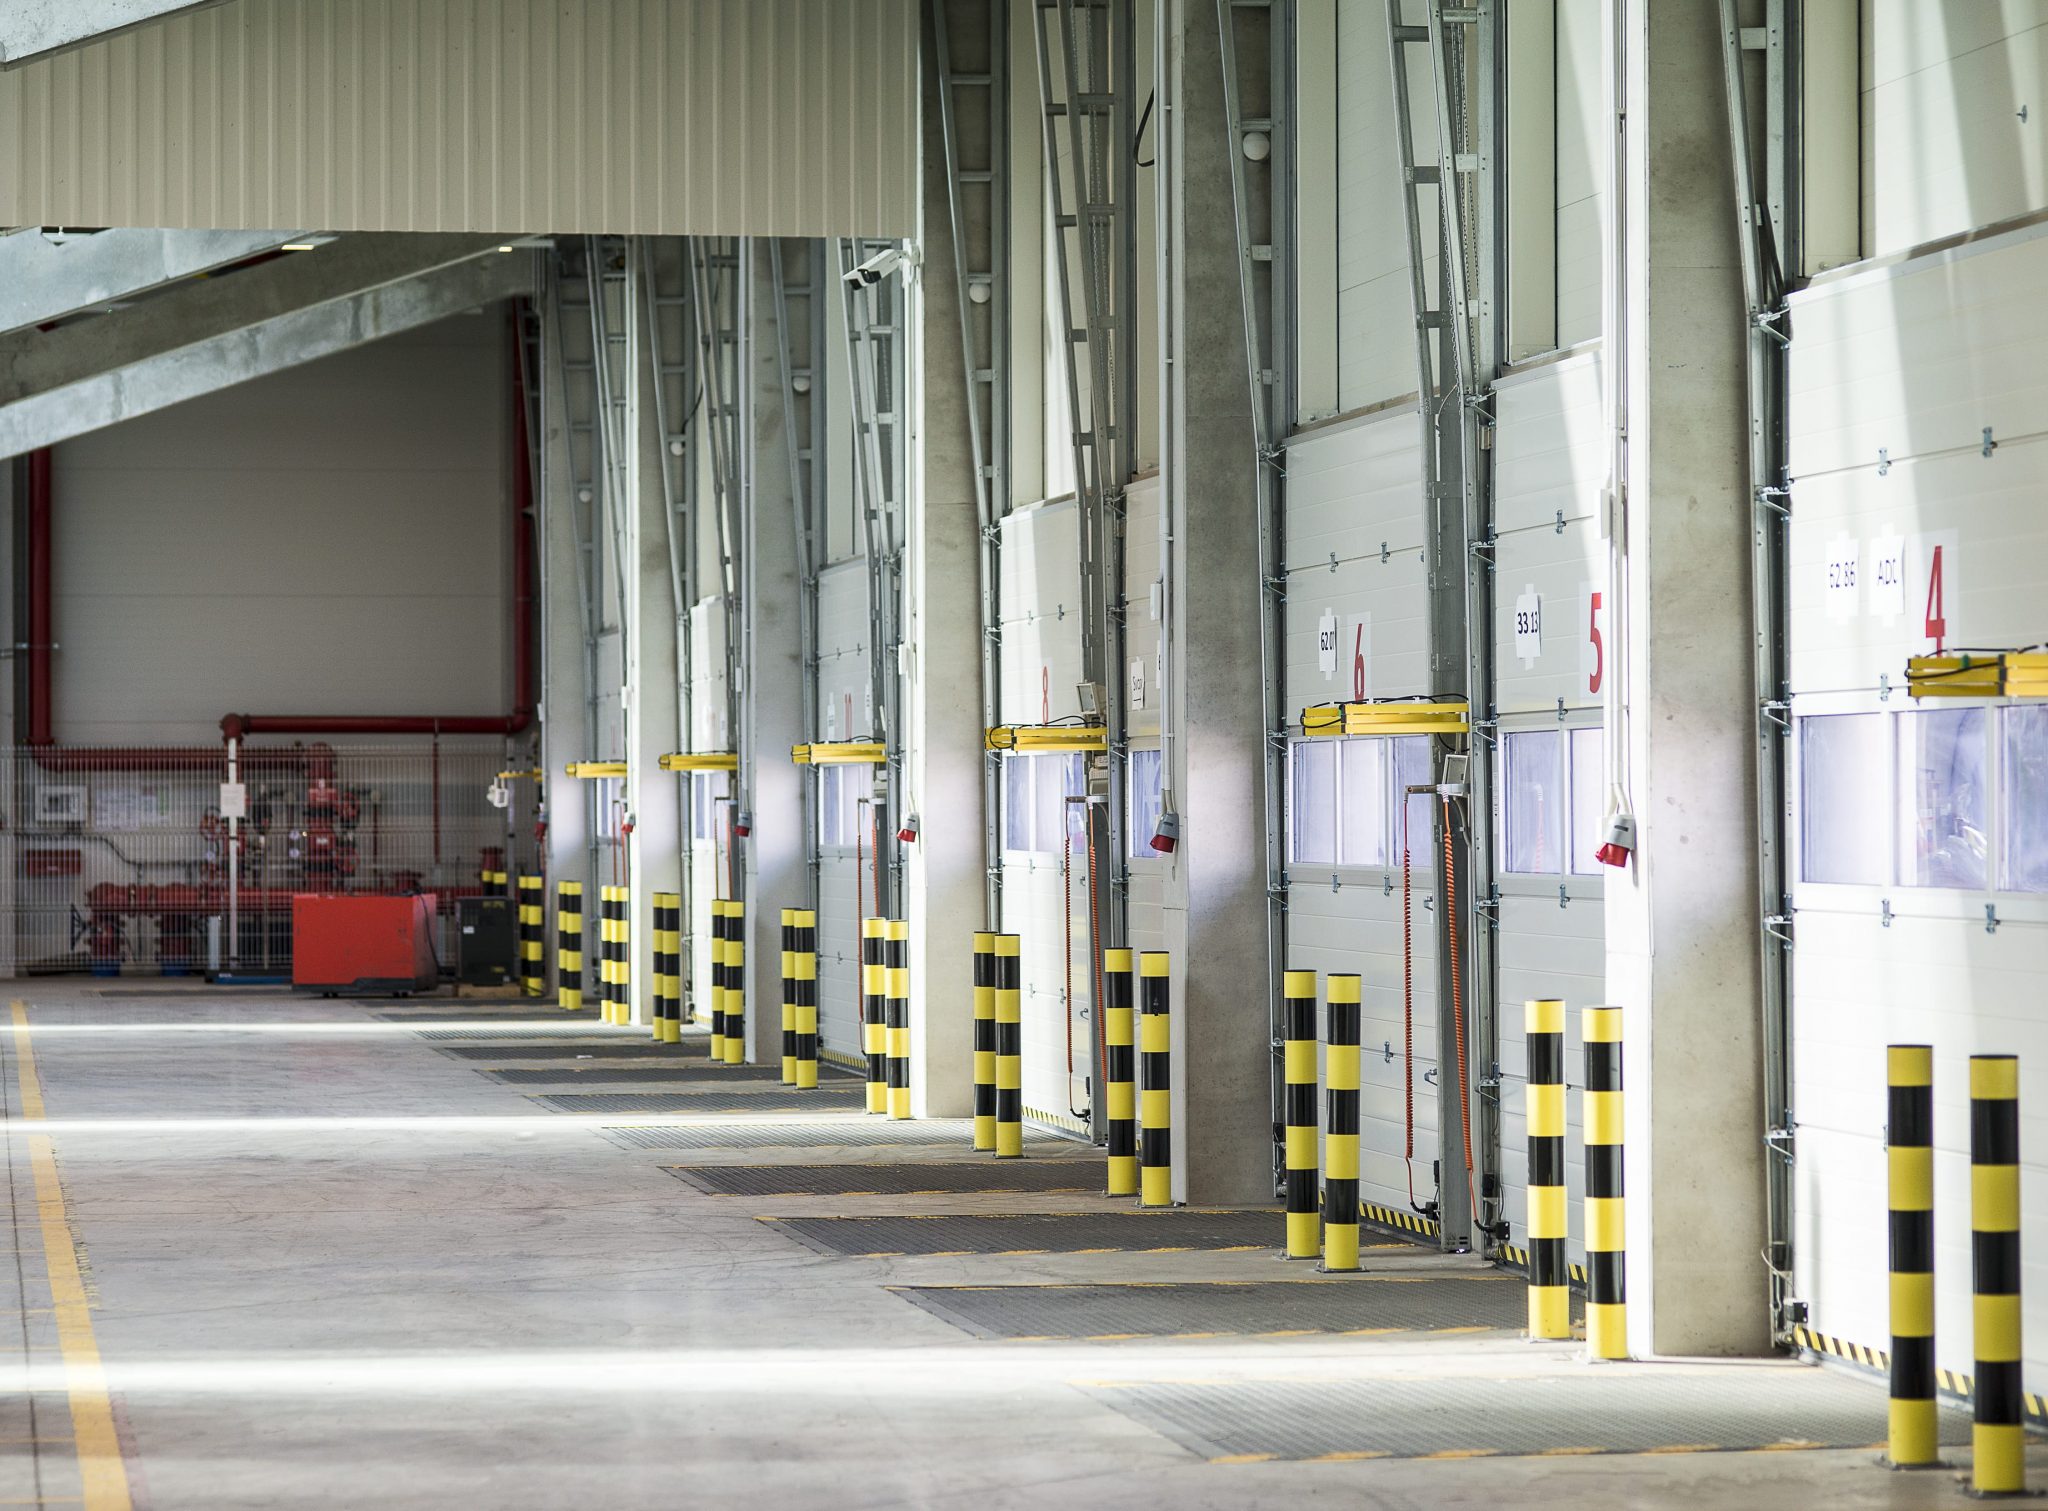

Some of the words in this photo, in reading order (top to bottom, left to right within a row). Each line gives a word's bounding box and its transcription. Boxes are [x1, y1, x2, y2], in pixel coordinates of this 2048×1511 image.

[1517, 612, 1529, 634] 33
[1590, 592, 1603, 693] 5
[1926, 545, 1946, 658] 4
[1354, 623, 1365, 703] 6
